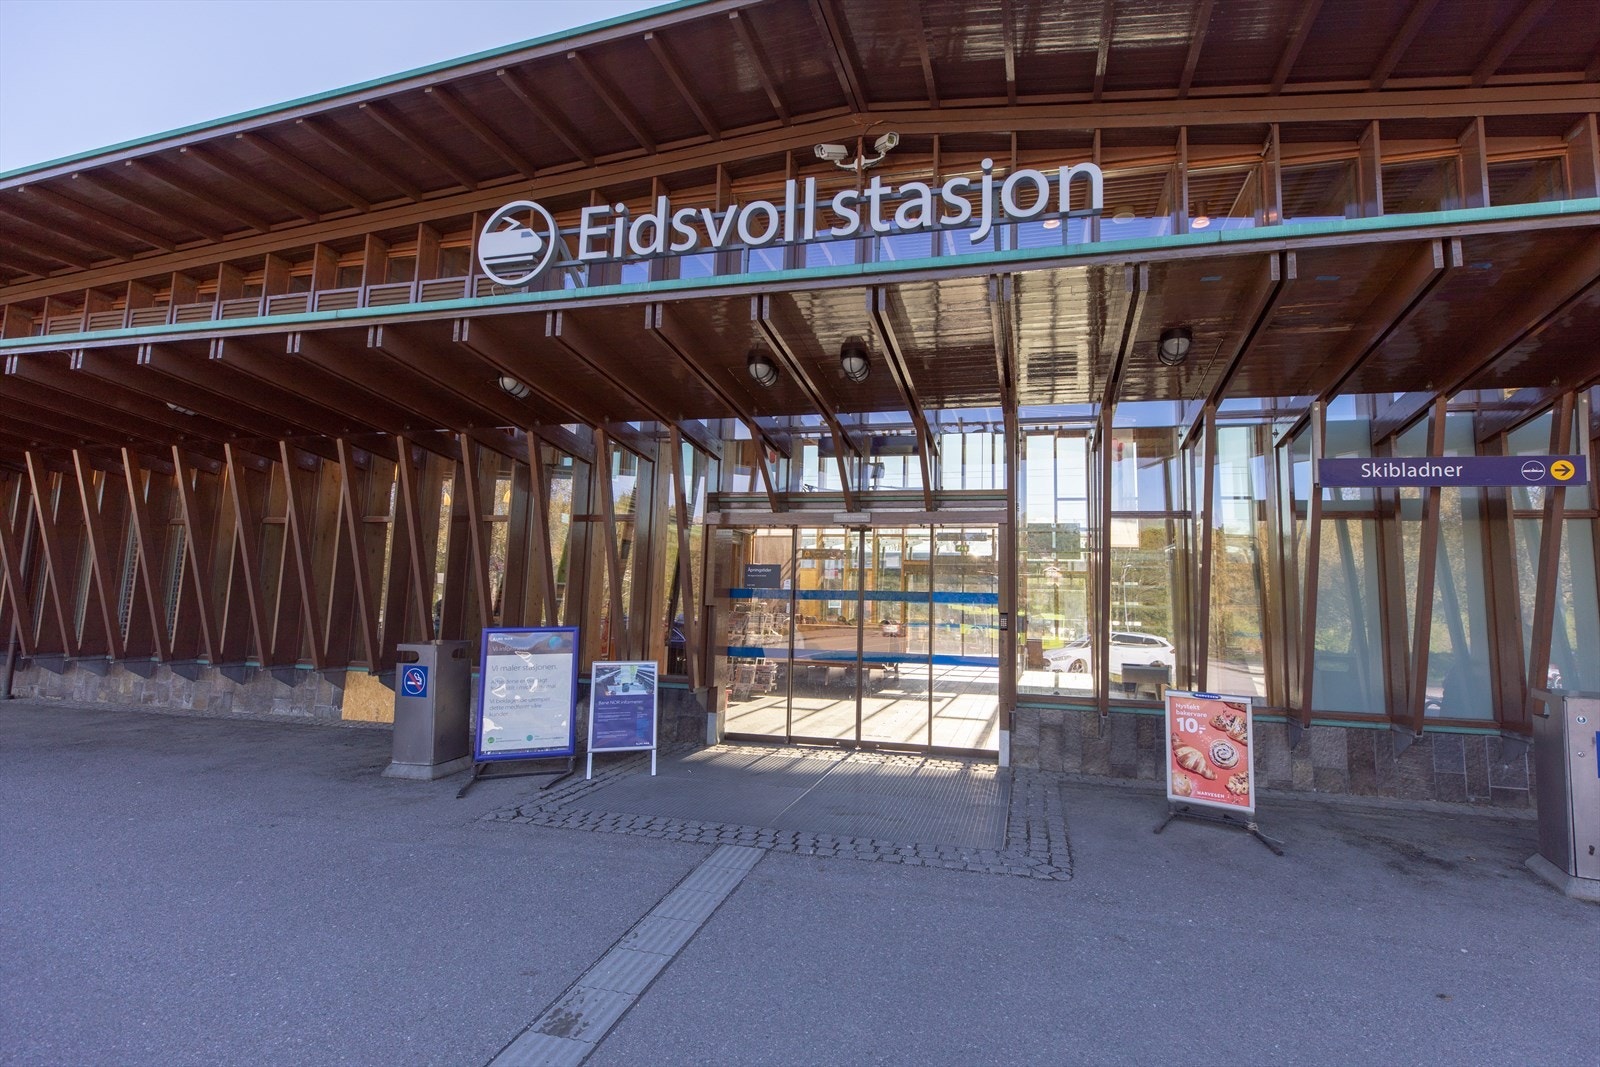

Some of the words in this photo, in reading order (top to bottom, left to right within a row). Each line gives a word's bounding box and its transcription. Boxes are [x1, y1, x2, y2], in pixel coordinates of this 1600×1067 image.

[578, 177, 818, 261] Eidsvoll
[830, 158, 1105, 244] stasjon
[1360, 462, 1463, 478] Skibladner
[500, 664, 521, 672] maler
[1175, 703, 1201, 711] Nystekt
[1175, 709, 1208, 718] bakervare
[1197, 790, 1225, 799] NARVESEN
